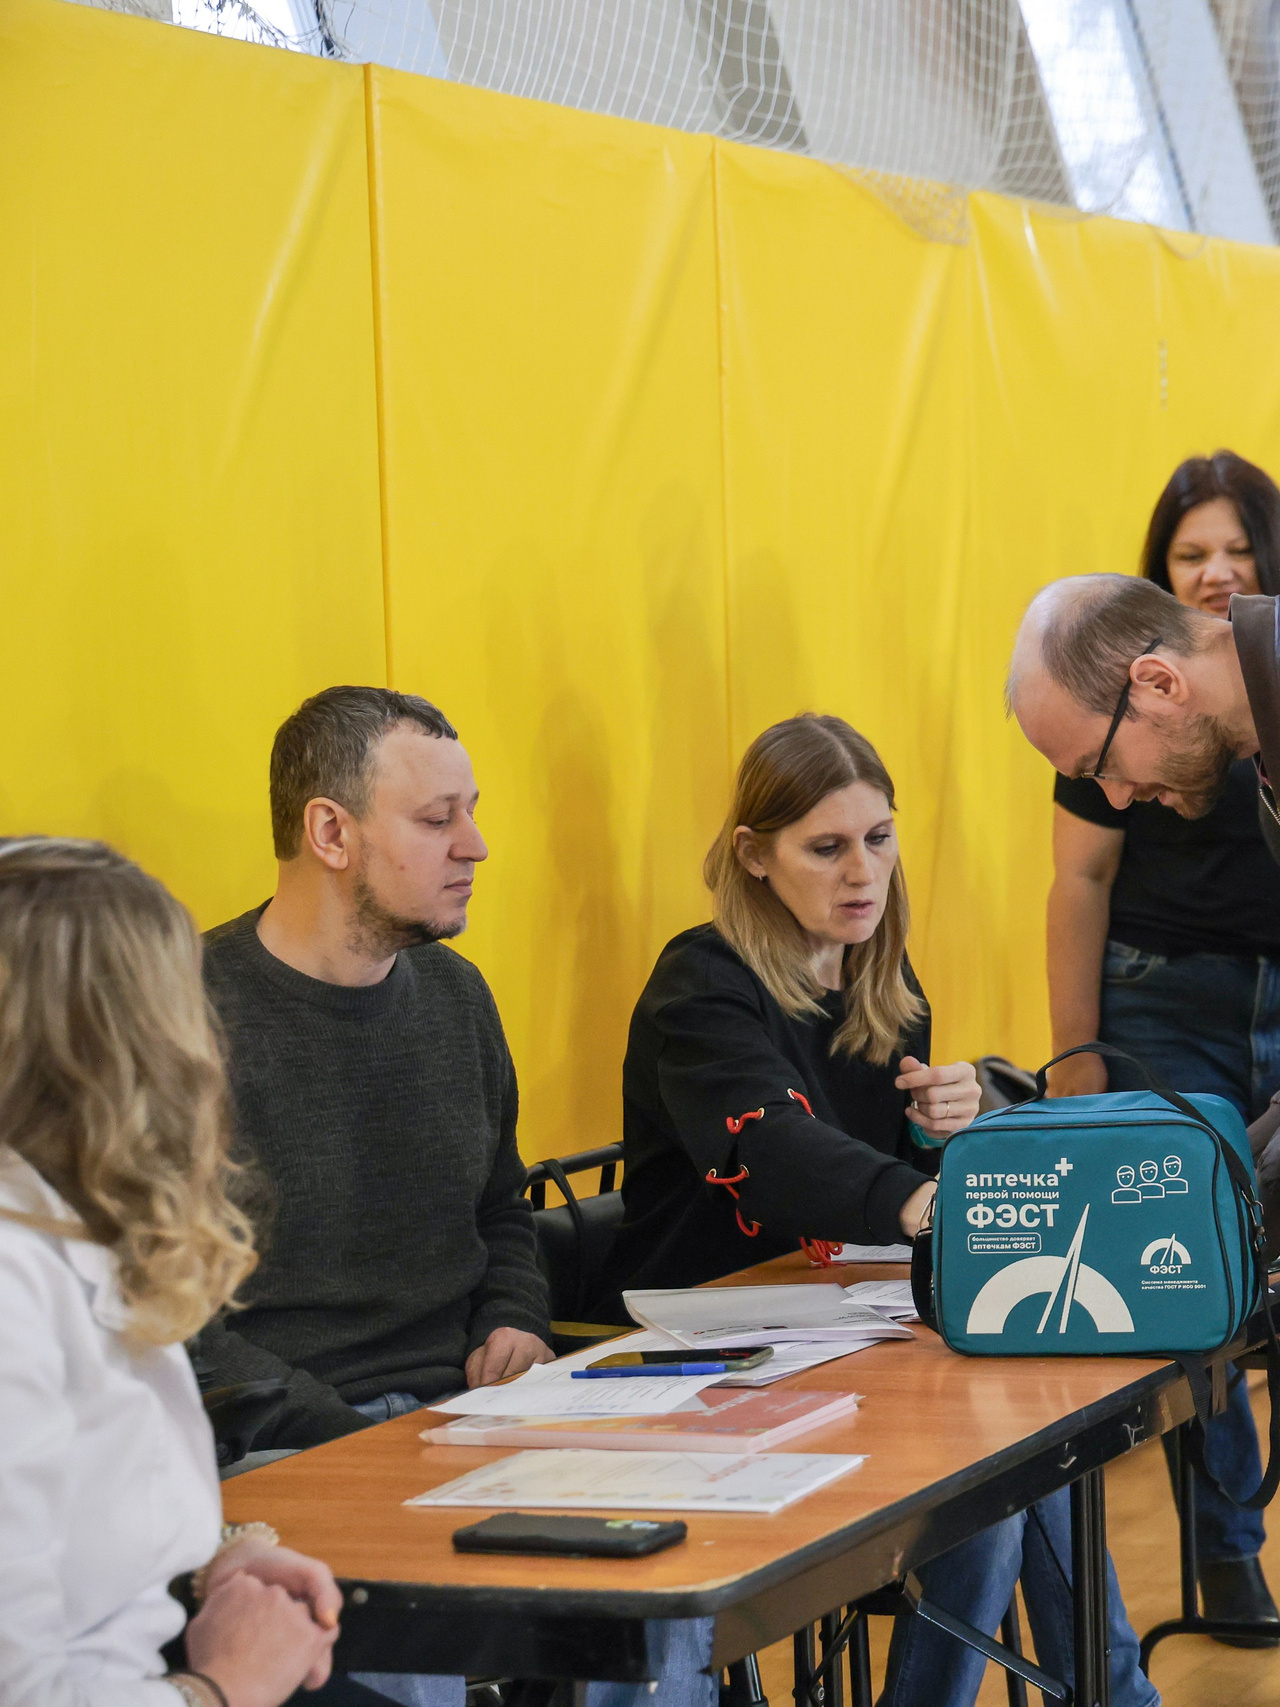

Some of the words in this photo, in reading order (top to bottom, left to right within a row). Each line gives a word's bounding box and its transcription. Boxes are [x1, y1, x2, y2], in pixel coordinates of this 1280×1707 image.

[965, 1173, 1059, 1187] аптечка
[965, 1189, 1009, 1201] первой
[1012, 1191, 1060, 1200] помощи
[966, 1203, 1060, 1229] ФЭСТ
[1012, 1242, 1036, 1250] ФЭСТ
[1150, 1265, 1183, 1274] ФЭСТ
